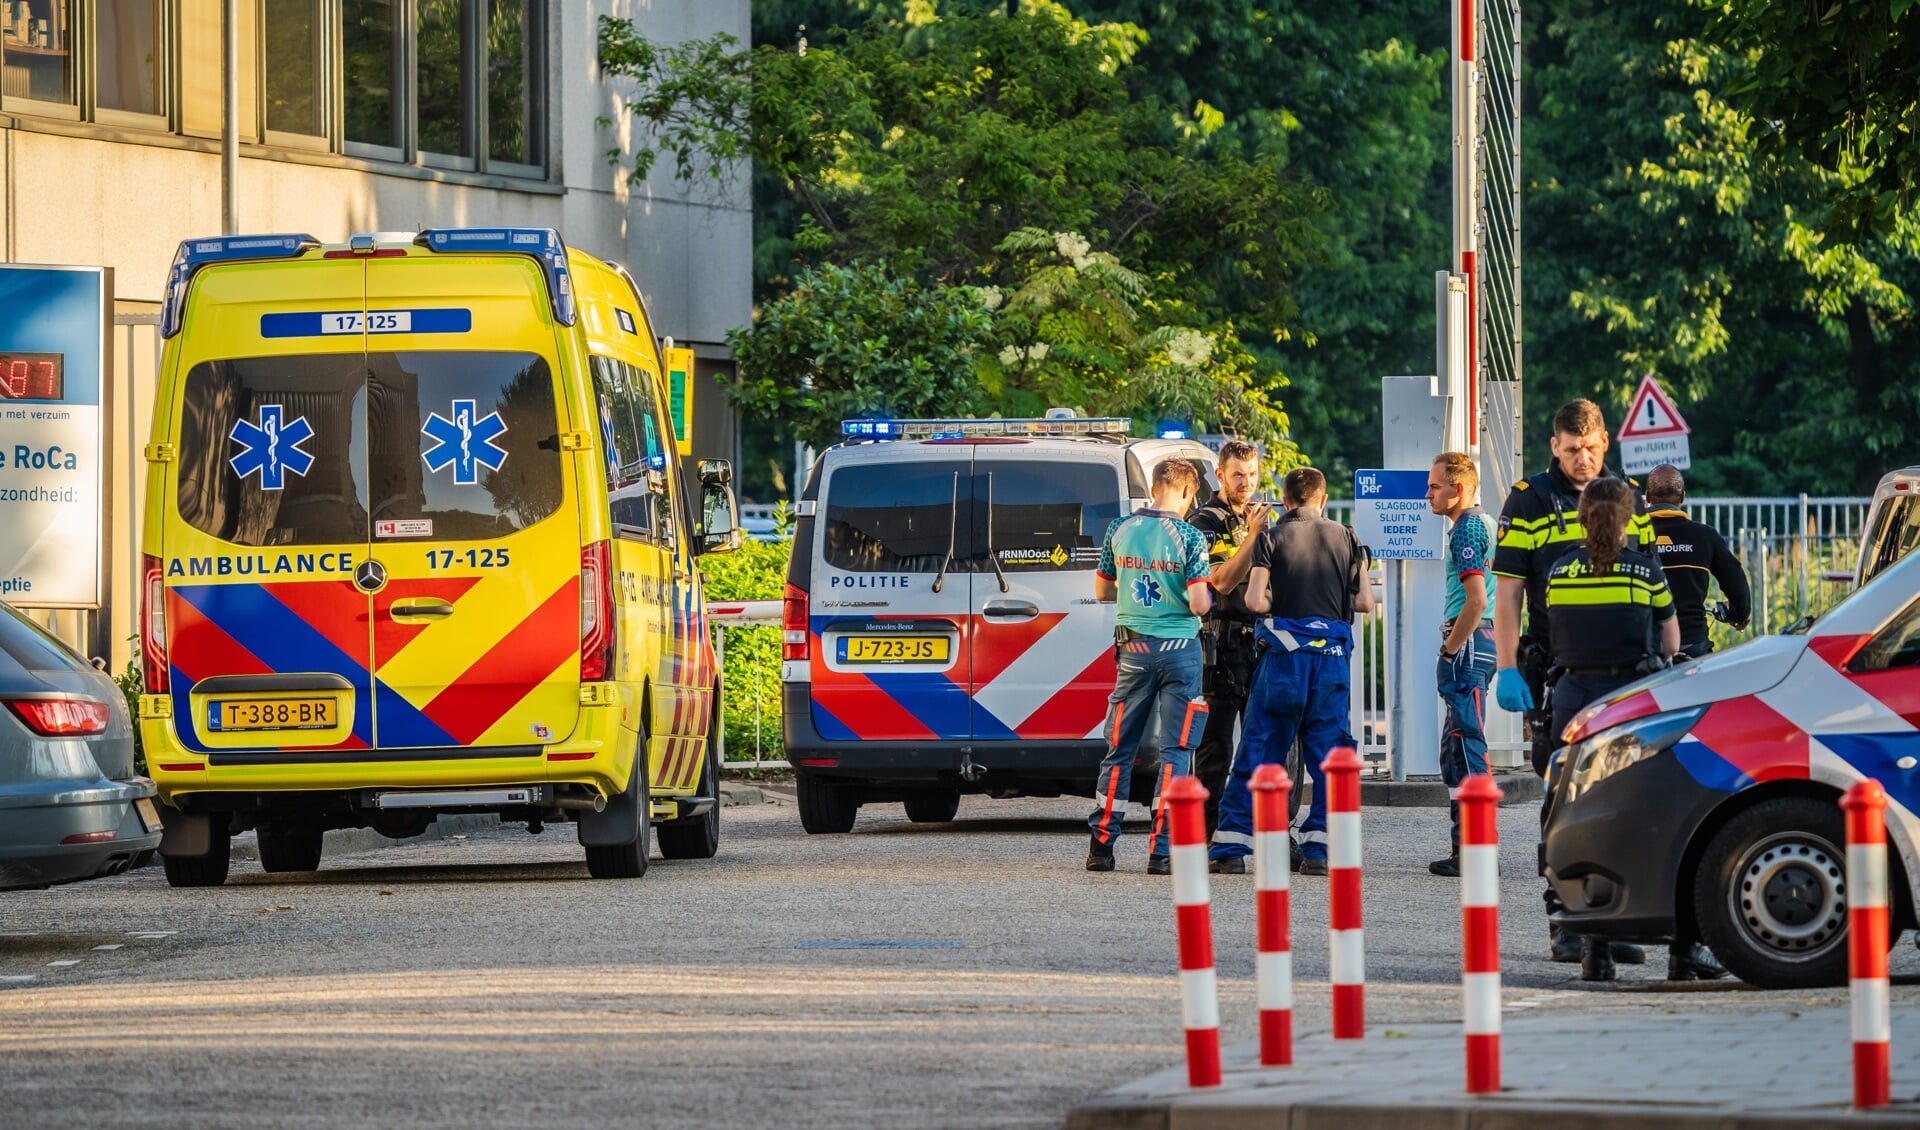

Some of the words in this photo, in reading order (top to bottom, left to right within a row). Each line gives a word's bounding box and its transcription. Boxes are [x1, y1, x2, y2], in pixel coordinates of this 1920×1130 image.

[335, 315, 397, 329] 17-125
[0, 361, 54, 397] 87
[6, 410, 26, 419] met
[31, 410, 70, 420] verzuim
[14, 445, 77, 470] RoCa
[1358, 473, 1376, 485] uni
[1361, 485, 1382, 496] per
[1375, 501, 1427, 510] SLAGBOOM
[1379, 513, 1406, 522] SLUIT
[1408, 513, 1422, 522] NA
[1383, 525, 1418, 534] IEDERE
[1387, 537, 1413, 546] AUTO
[998, 549, 1051, 559] #RNMOost
[1657, 544, 1693, 553] MOURIK
[425, 548, 510, 569] 17-125
[167, 553, 353, 577] AMBULANCE
[0, 576, 32, 595] ptie
[831, 576, 910, 588] POLITIE
[865, 623, 915, 631] Mercedes-Benz
[854, 641, 934, 658] J-723-JS
[228, 703, 327, 724] T-388-BR
